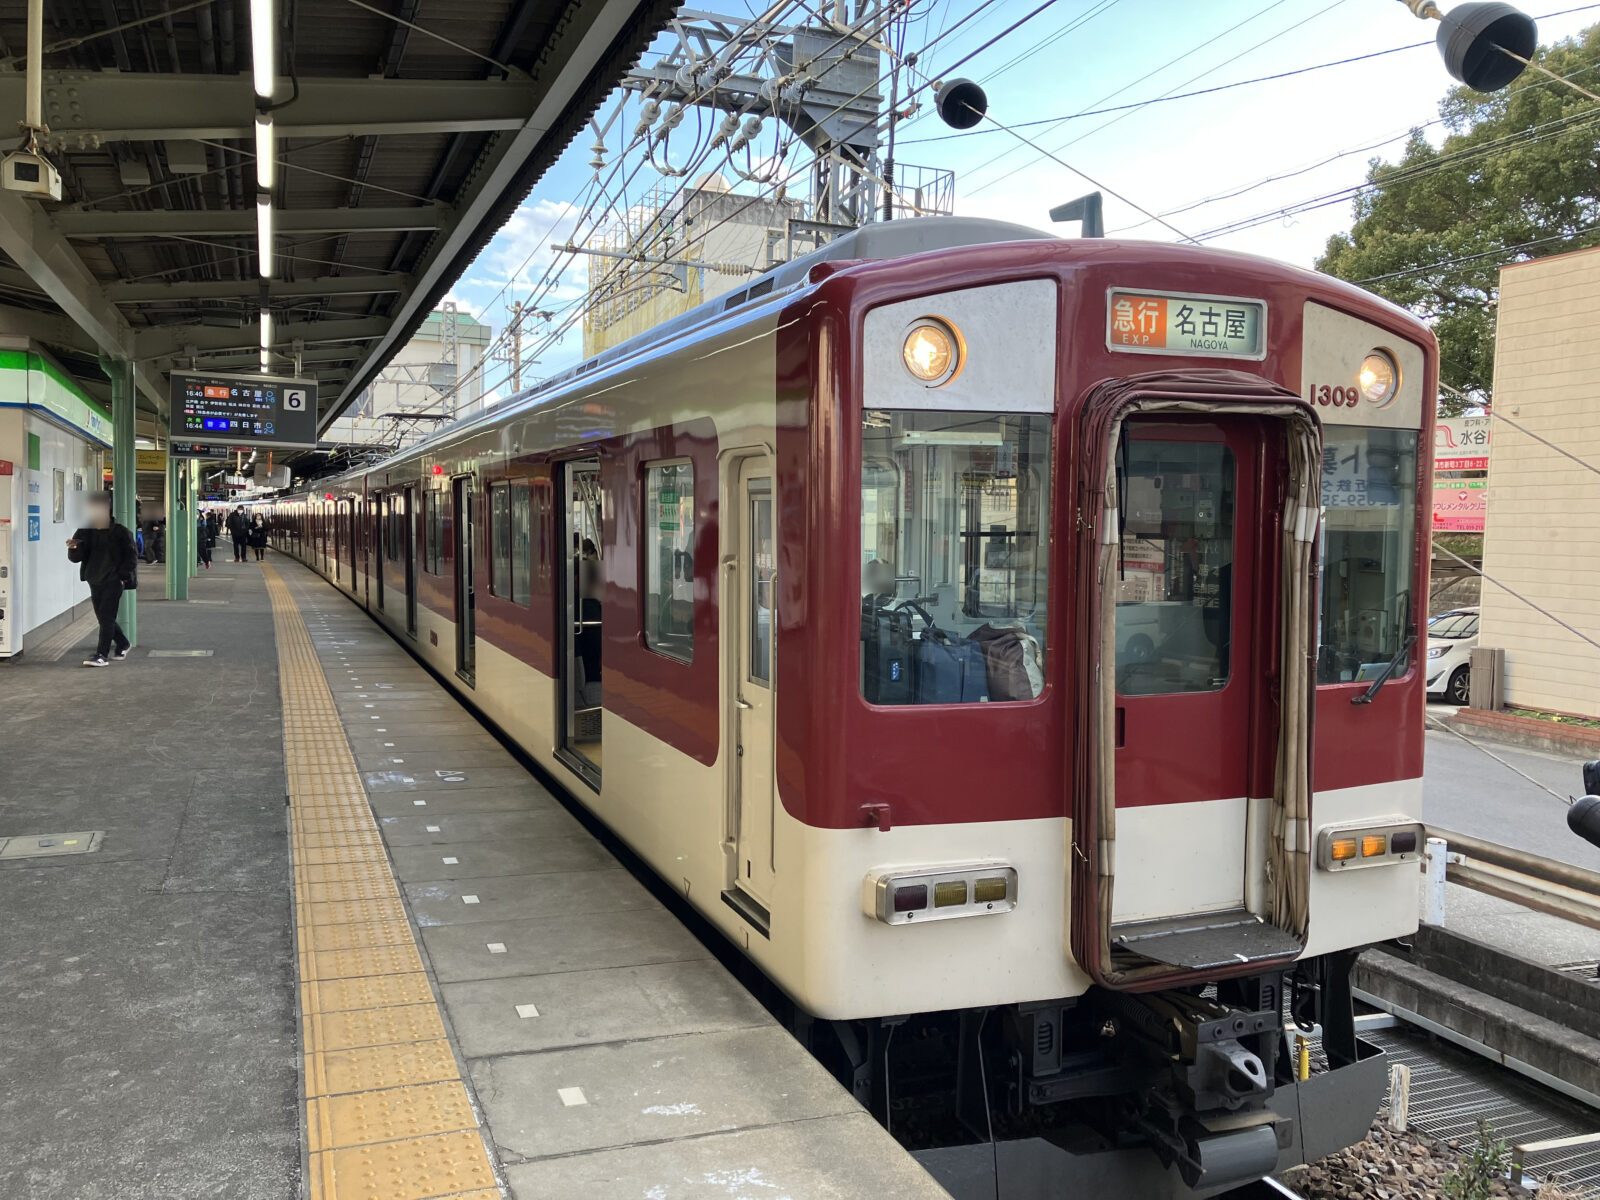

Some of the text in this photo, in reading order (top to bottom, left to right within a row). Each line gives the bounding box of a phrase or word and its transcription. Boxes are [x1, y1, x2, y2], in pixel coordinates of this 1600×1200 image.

[1114, 299, 1246, 340] 急行 名古屋
[1190, 338, 1229, 351] NAGOYA
[230, 388, 262, 397] 名古屋
[287, 391, 302, 409] 6
[1310, 383, 1360, 408] 1309
[229, 420, 262, 430] 四日市
[1460, 429, 1491, 446] 水谷
